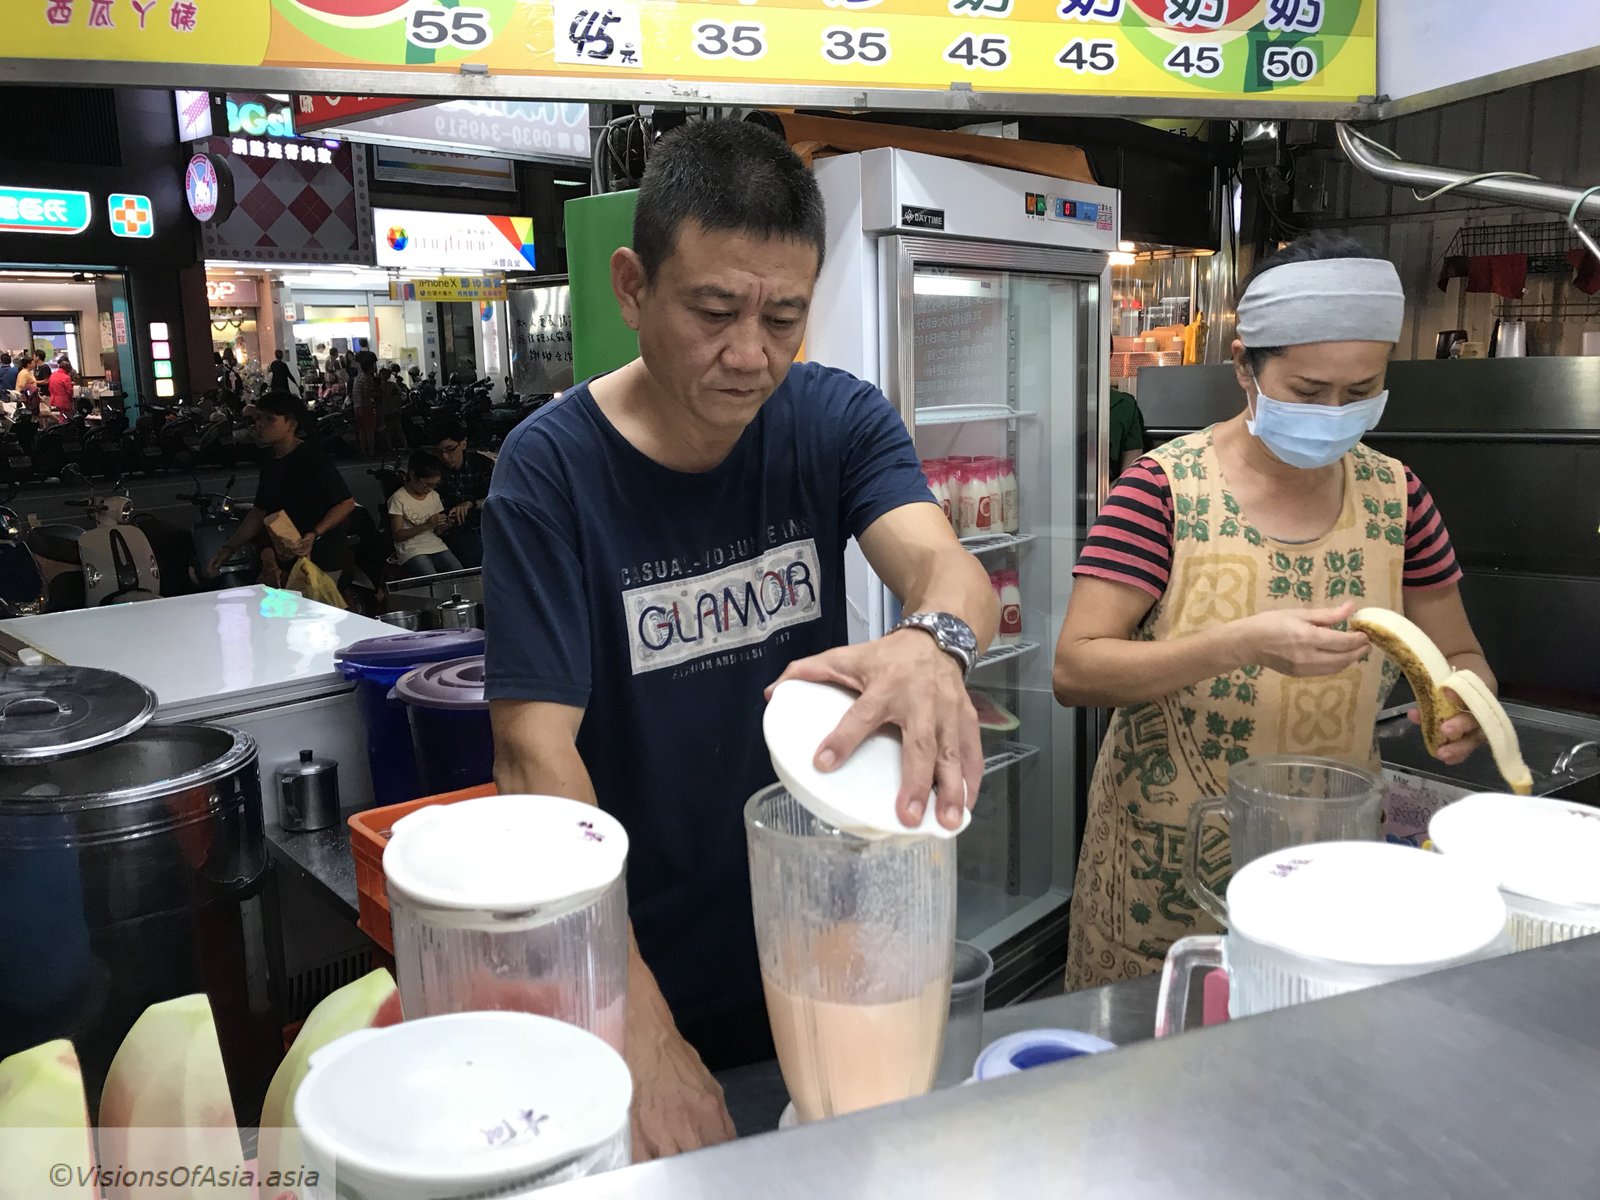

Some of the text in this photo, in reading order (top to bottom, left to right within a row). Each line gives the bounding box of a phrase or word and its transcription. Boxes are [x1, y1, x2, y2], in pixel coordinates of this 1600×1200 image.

[411, 9, 487, 45] 55
[697, 23, 762, 57] 35
[826, 30, 887, 62] 35
[947, 36, 1007, 67] 45
[1058, 41, 1115, 71] 45
[1167, 45, 1220, 74] 45
[1265, 51, 1314, 78] 50
[914, 212, 943, 226] DAYTIME
[638, 560, 816, 651] GLAMOR
